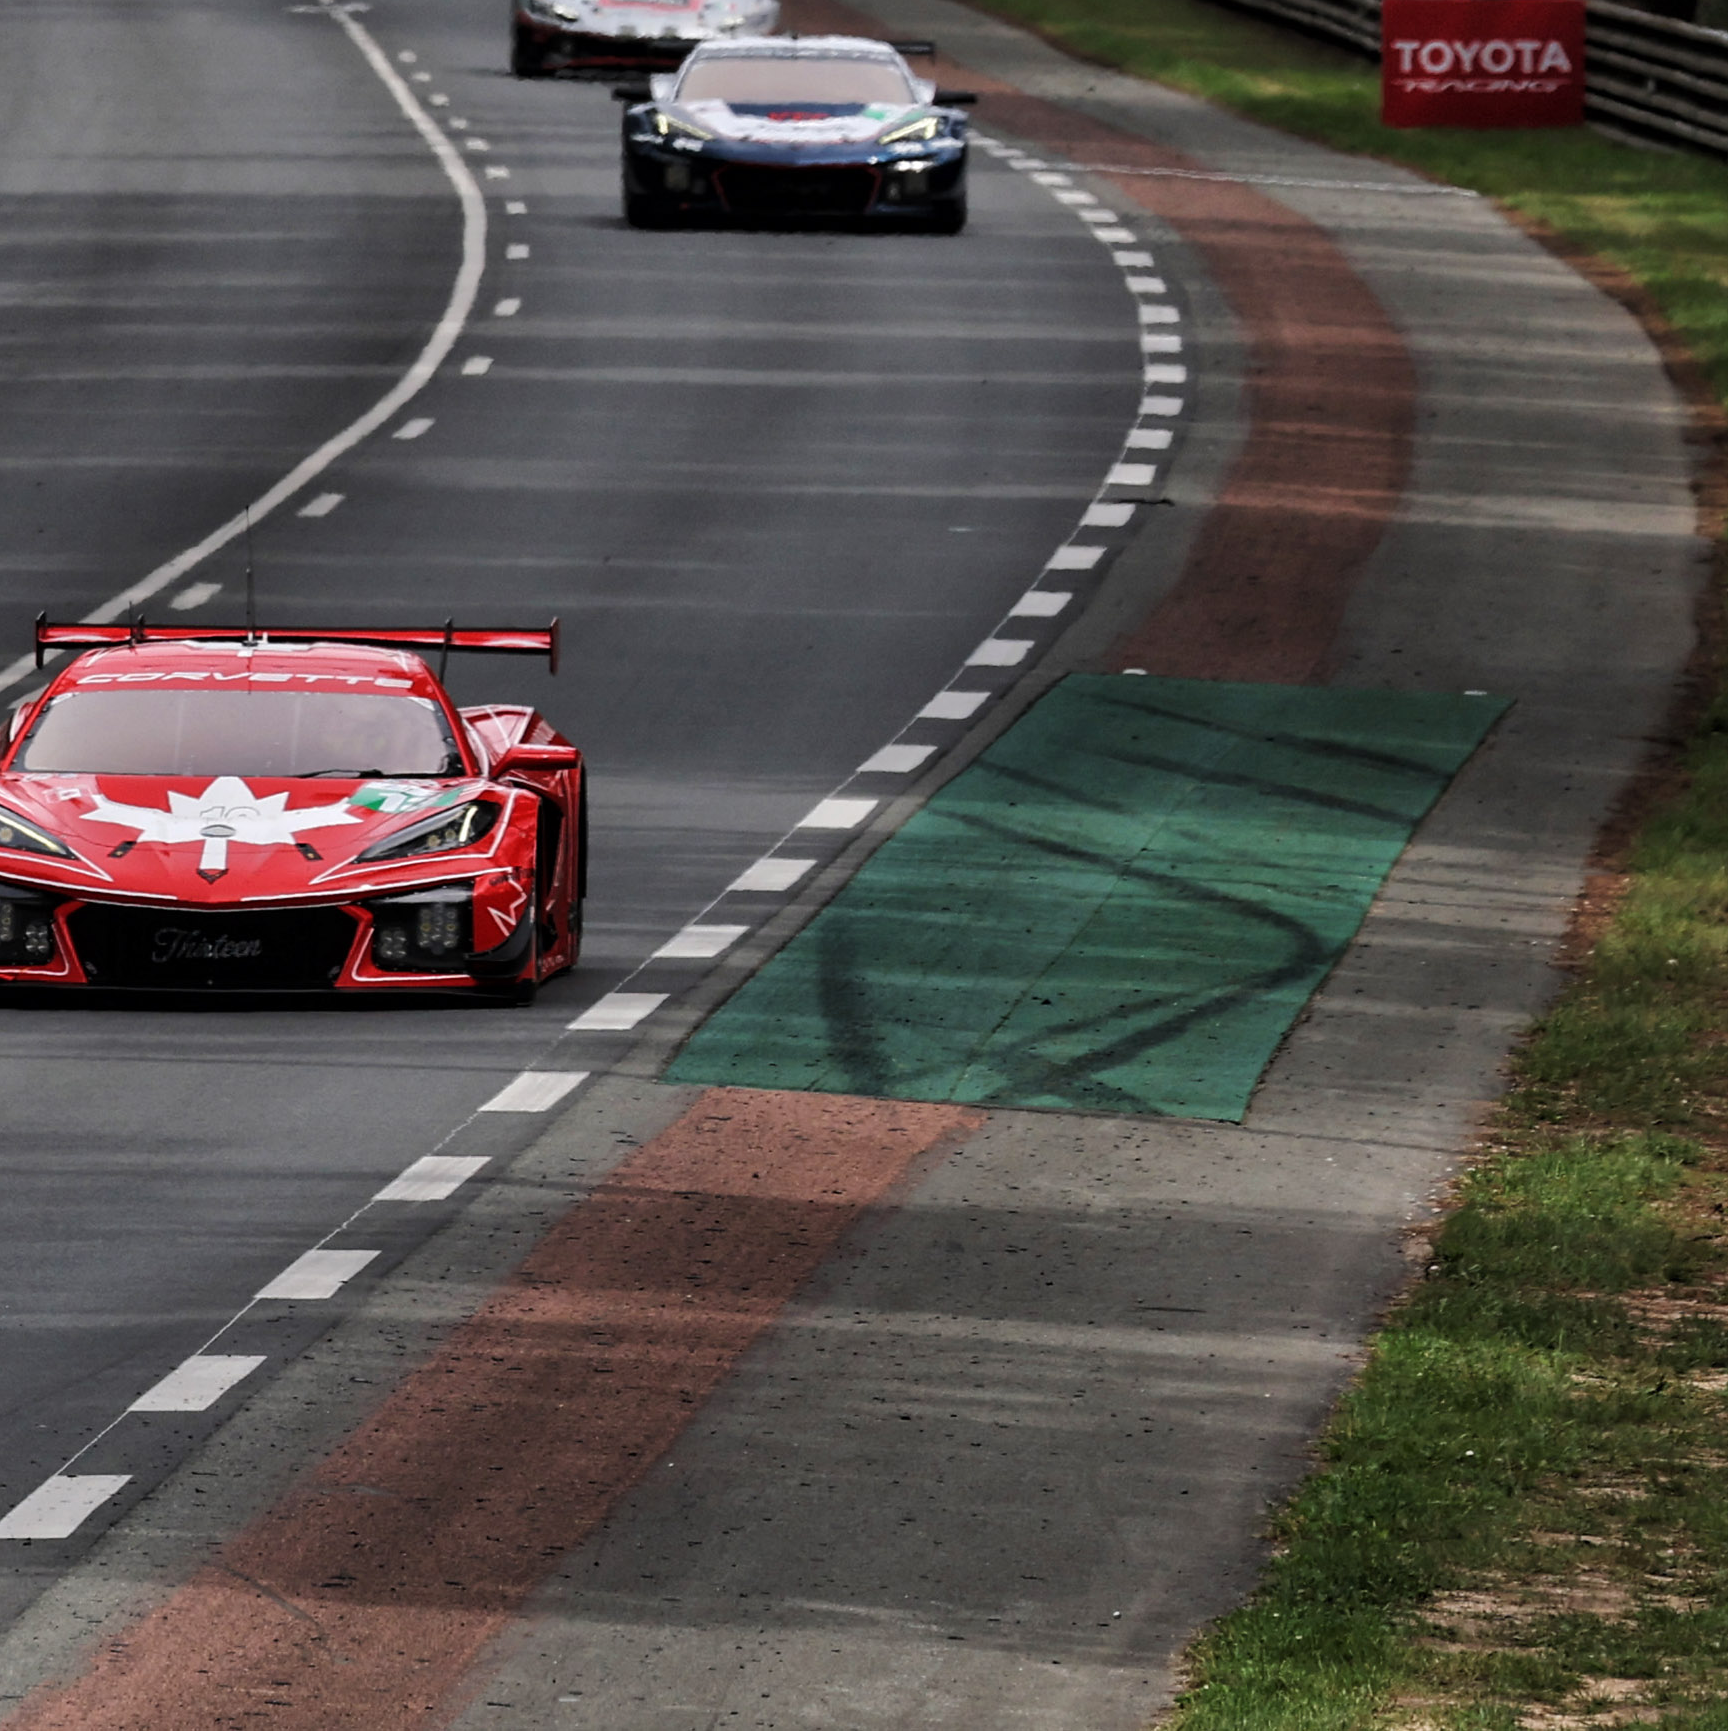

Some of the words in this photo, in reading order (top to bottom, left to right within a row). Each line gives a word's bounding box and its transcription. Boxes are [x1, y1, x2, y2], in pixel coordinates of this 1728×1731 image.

[1392, 40, 1572, 73] TOYOTA
[76, 671, 414, 689] CORVETTE
[152, 928, 261, 962] Thirteen
